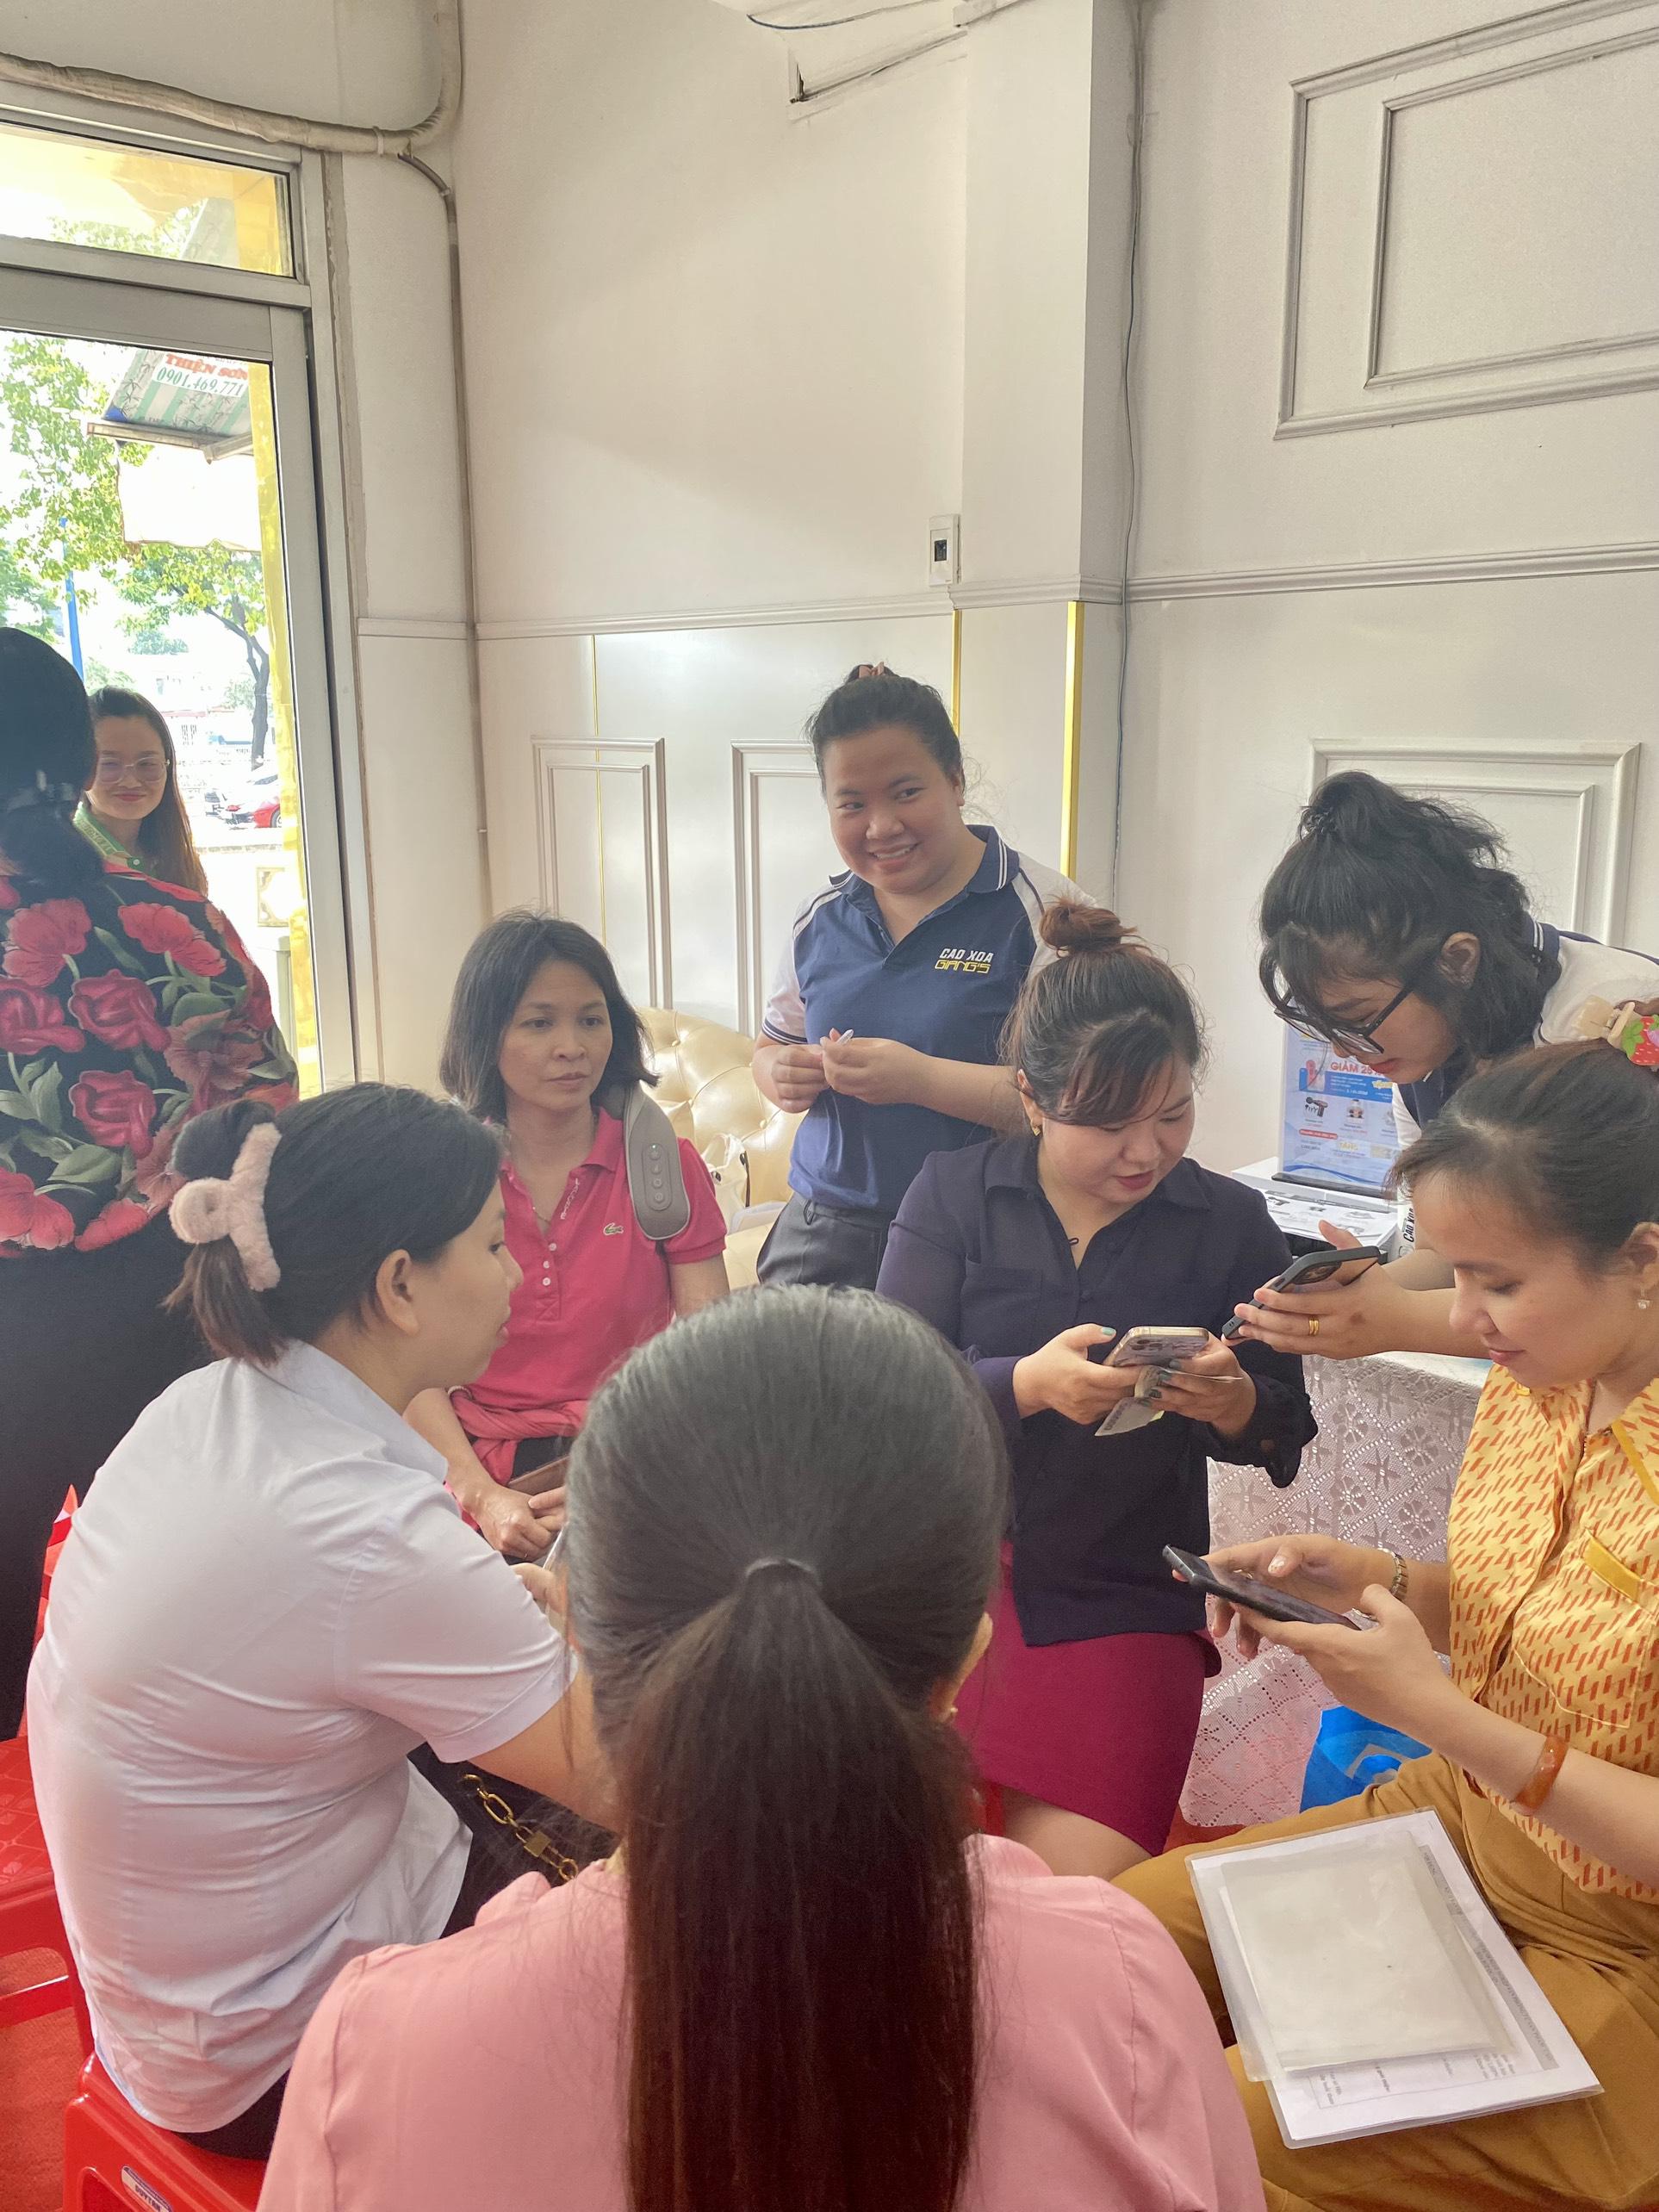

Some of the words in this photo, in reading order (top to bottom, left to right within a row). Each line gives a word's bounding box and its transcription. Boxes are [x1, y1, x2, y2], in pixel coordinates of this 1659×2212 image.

[157, 366, 244, 396] 0901.469.771
[939, 948, 966, 960] CAO
[966, 950, 994, 963] XOA
